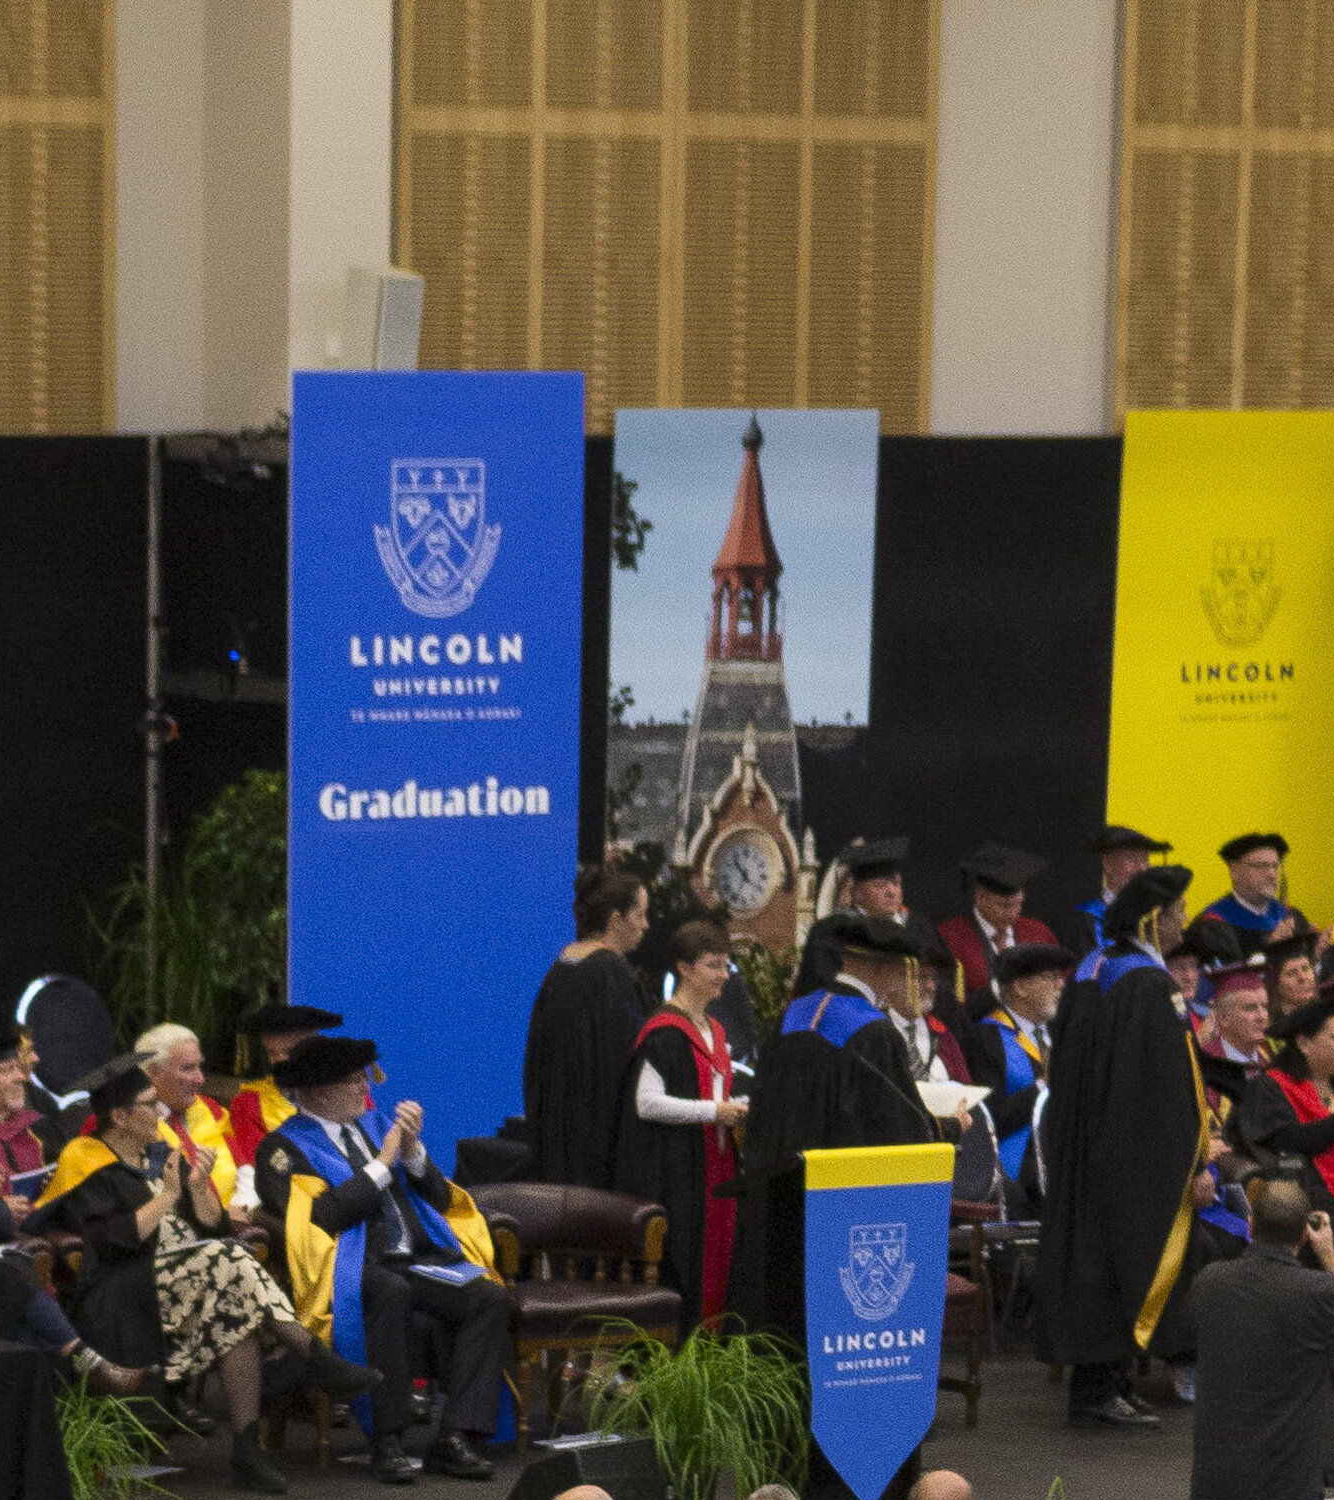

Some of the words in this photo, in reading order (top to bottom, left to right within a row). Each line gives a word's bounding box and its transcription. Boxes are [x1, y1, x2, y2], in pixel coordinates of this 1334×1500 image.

[350, 633, 523, 667] LINCOLN
[1181, 662, 1295, 683] LINCOLN
[373, 676, 500, 697] UNIVERSITY
[319, 776, 551, 821] Graduation
[823, 1328, 926, 1354] LINCOLN
[835, 1355, 911, 1371] UNIVERSITY
